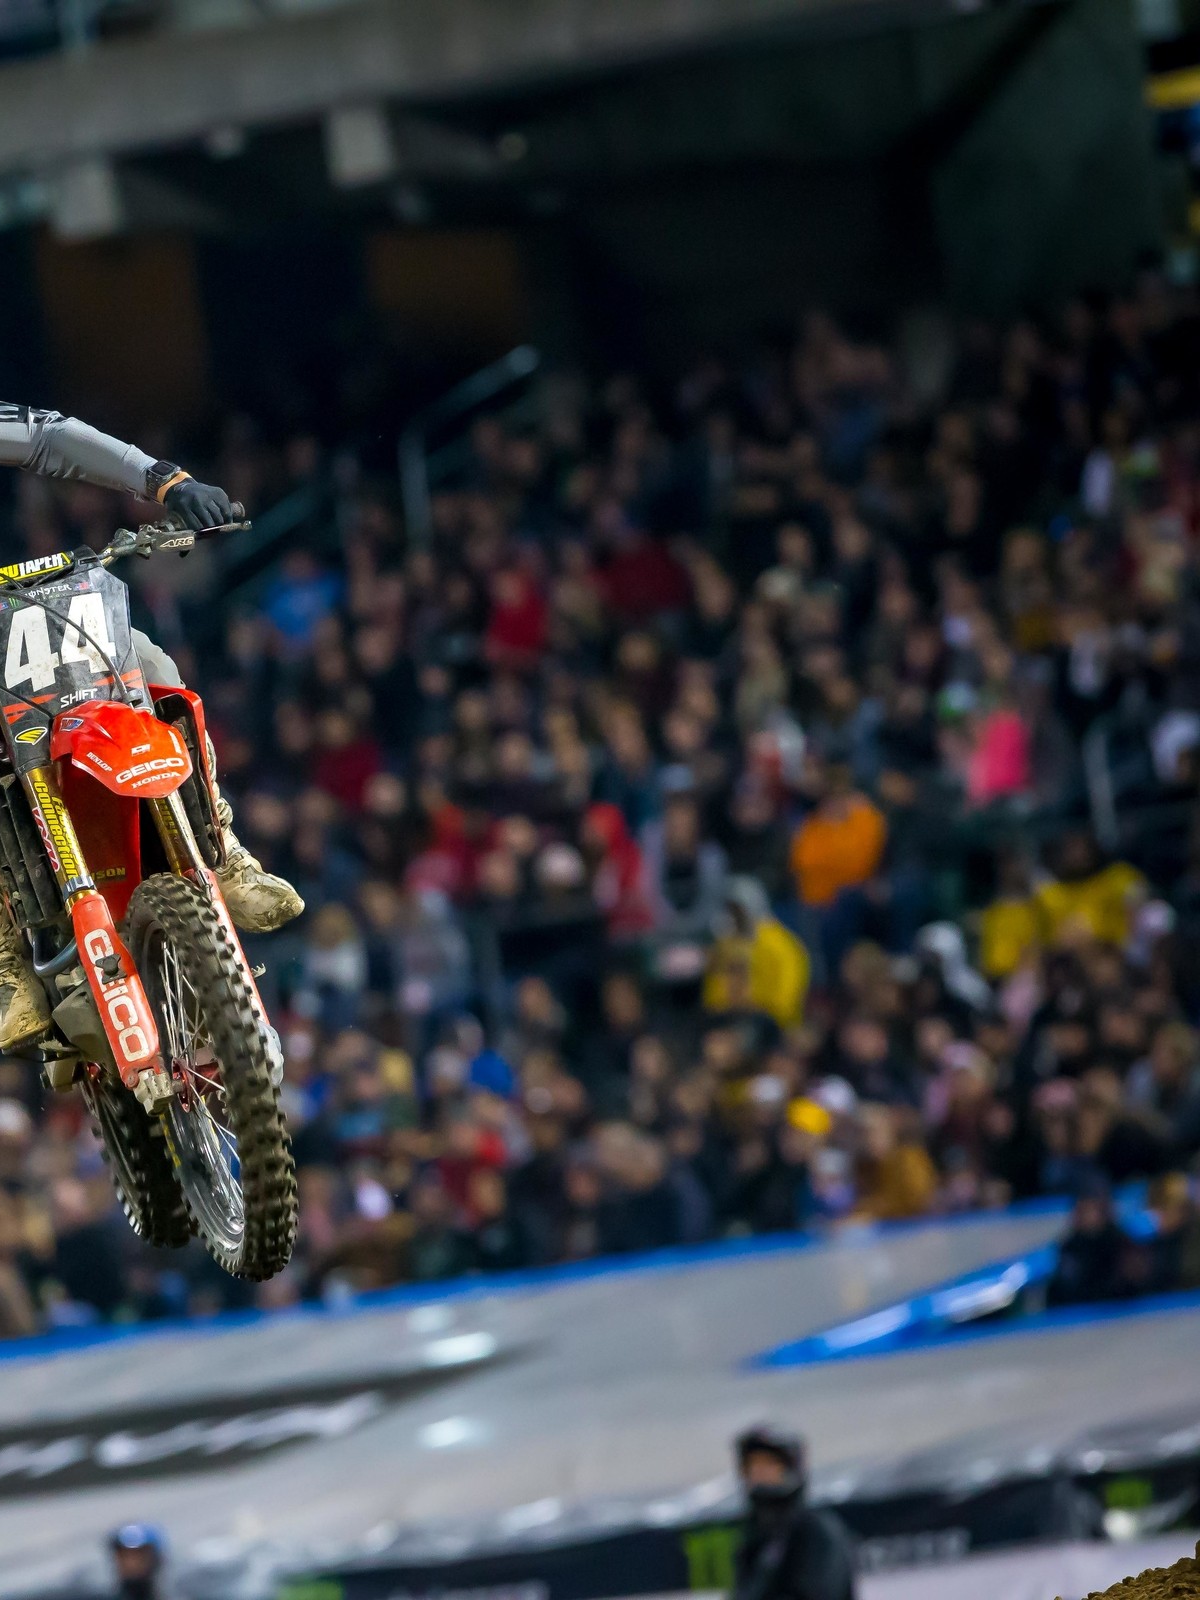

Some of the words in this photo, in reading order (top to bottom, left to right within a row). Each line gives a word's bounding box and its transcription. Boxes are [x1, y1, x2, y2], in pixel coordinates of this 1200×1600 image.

[23, 583, 72, 599] ONSTER
[4, 592, 117, 692] 44
[60, 688, 98, 709] SHIFT
[86, 751, 113, 772] DUNLOP
[115, 757, 185, 784] GEICO
[131, 771, 182, 789] HONDA
